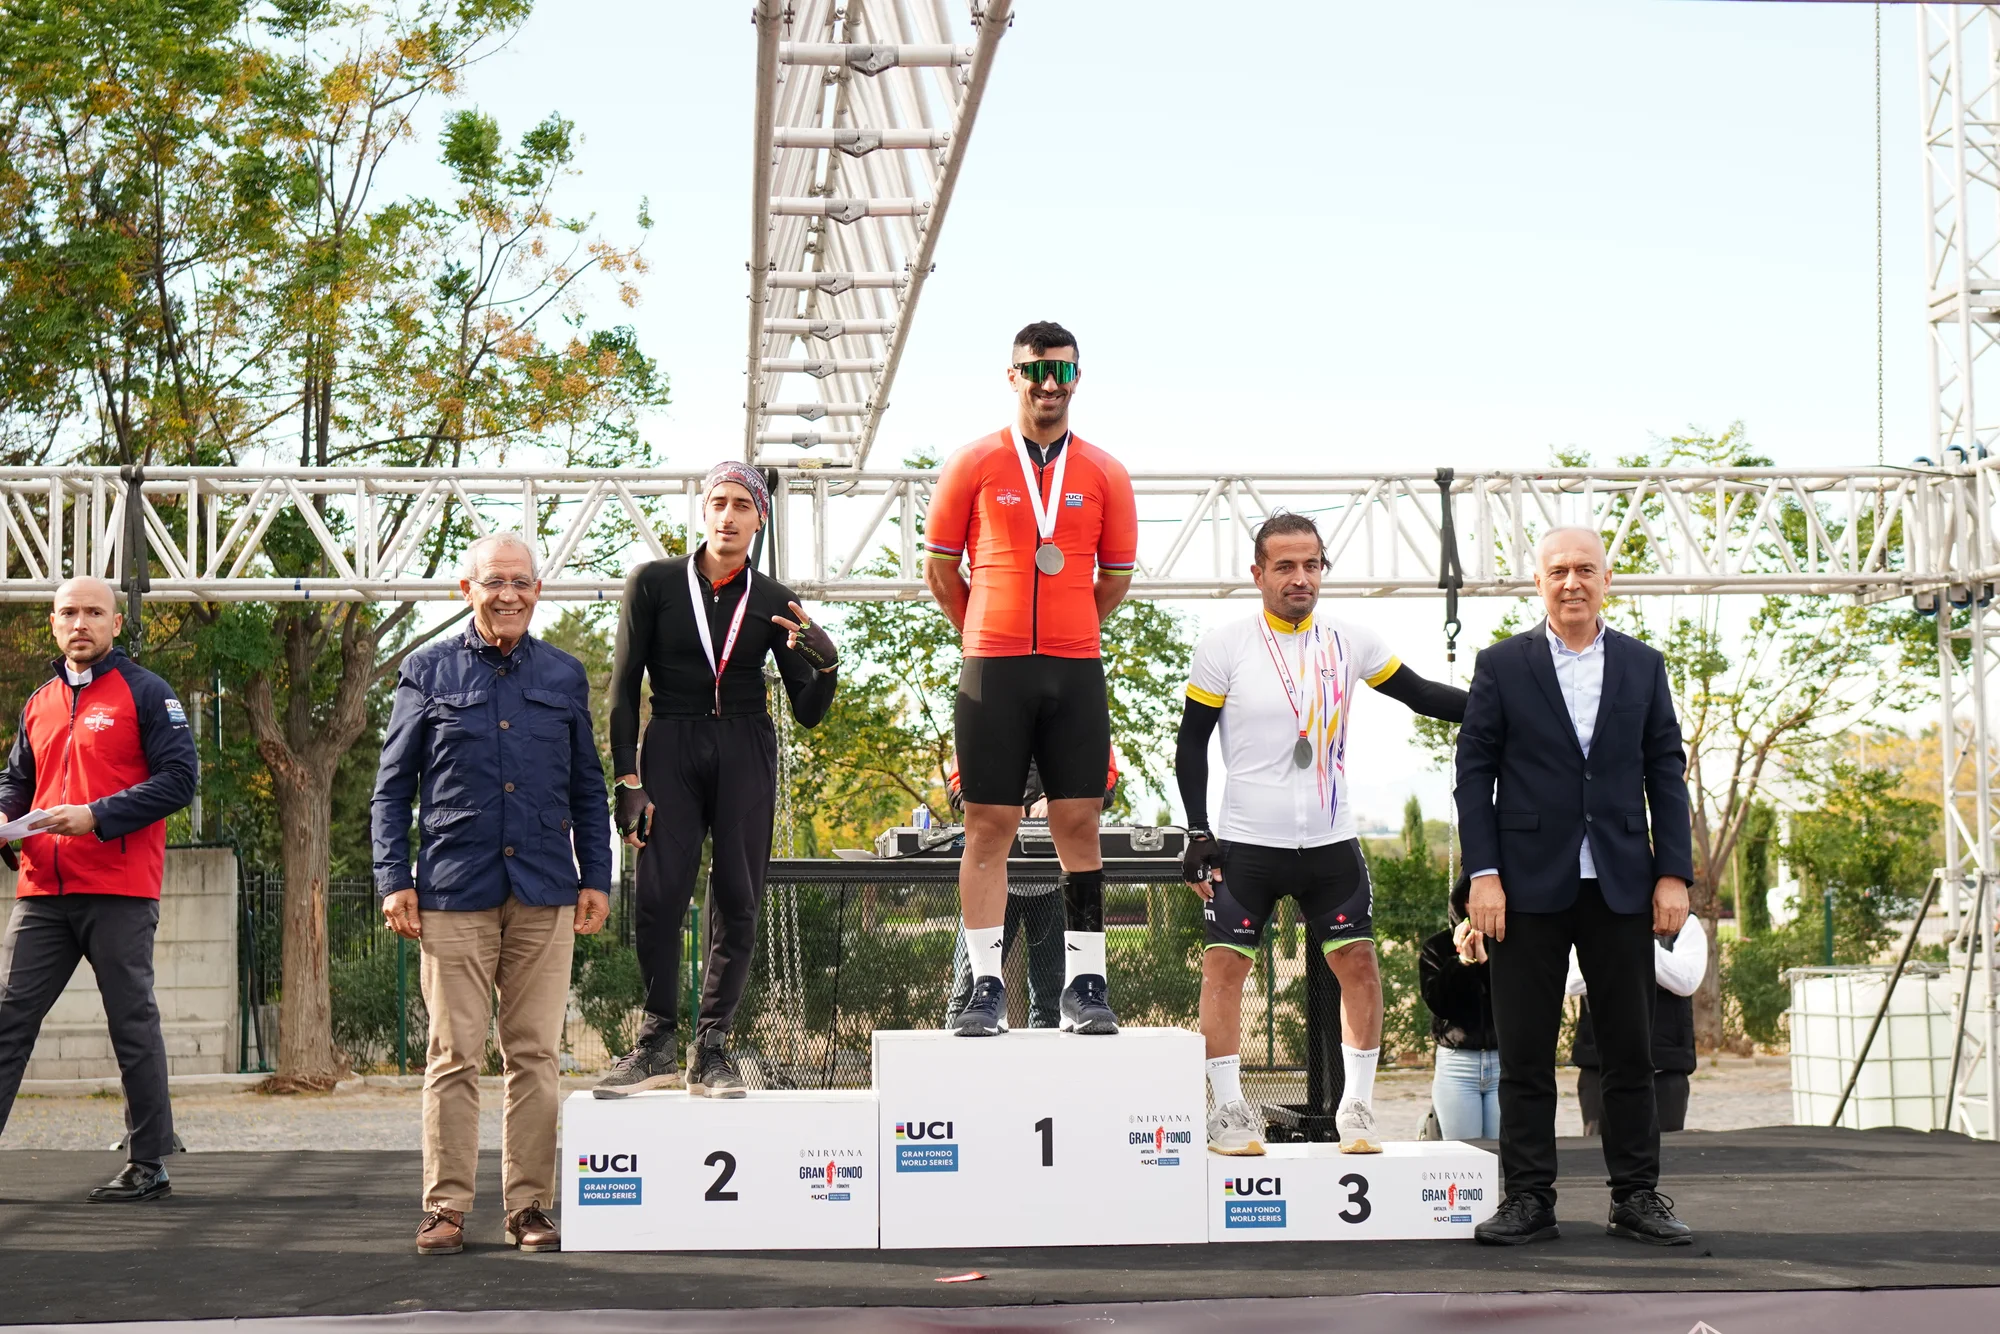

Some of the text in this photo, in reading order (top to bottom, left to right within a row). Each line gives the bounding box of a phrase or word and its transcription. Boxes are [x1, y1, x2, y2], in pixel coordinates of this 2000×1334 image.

[169, 701, 182, 709] UC
[907, 1121, 953, 1140] UCI
[1129, 1131, 1191, 1145] GRAN FONDO
[1034, 1117, 1053, 1166] 1
[590, 1154, 637, 1172] UCI
[704, 1151, 738, 1201] 2
[800, 1166, 862, 1179] GRAN FONDO
[1430, 1172, 1482, 1180] NIRVANA
[1236, 1178, 1280, 1196] UCI
[1422, 1188, 1482, 1202] GRAN FONDO
[1338, 1173, 1371, 1223] 3
